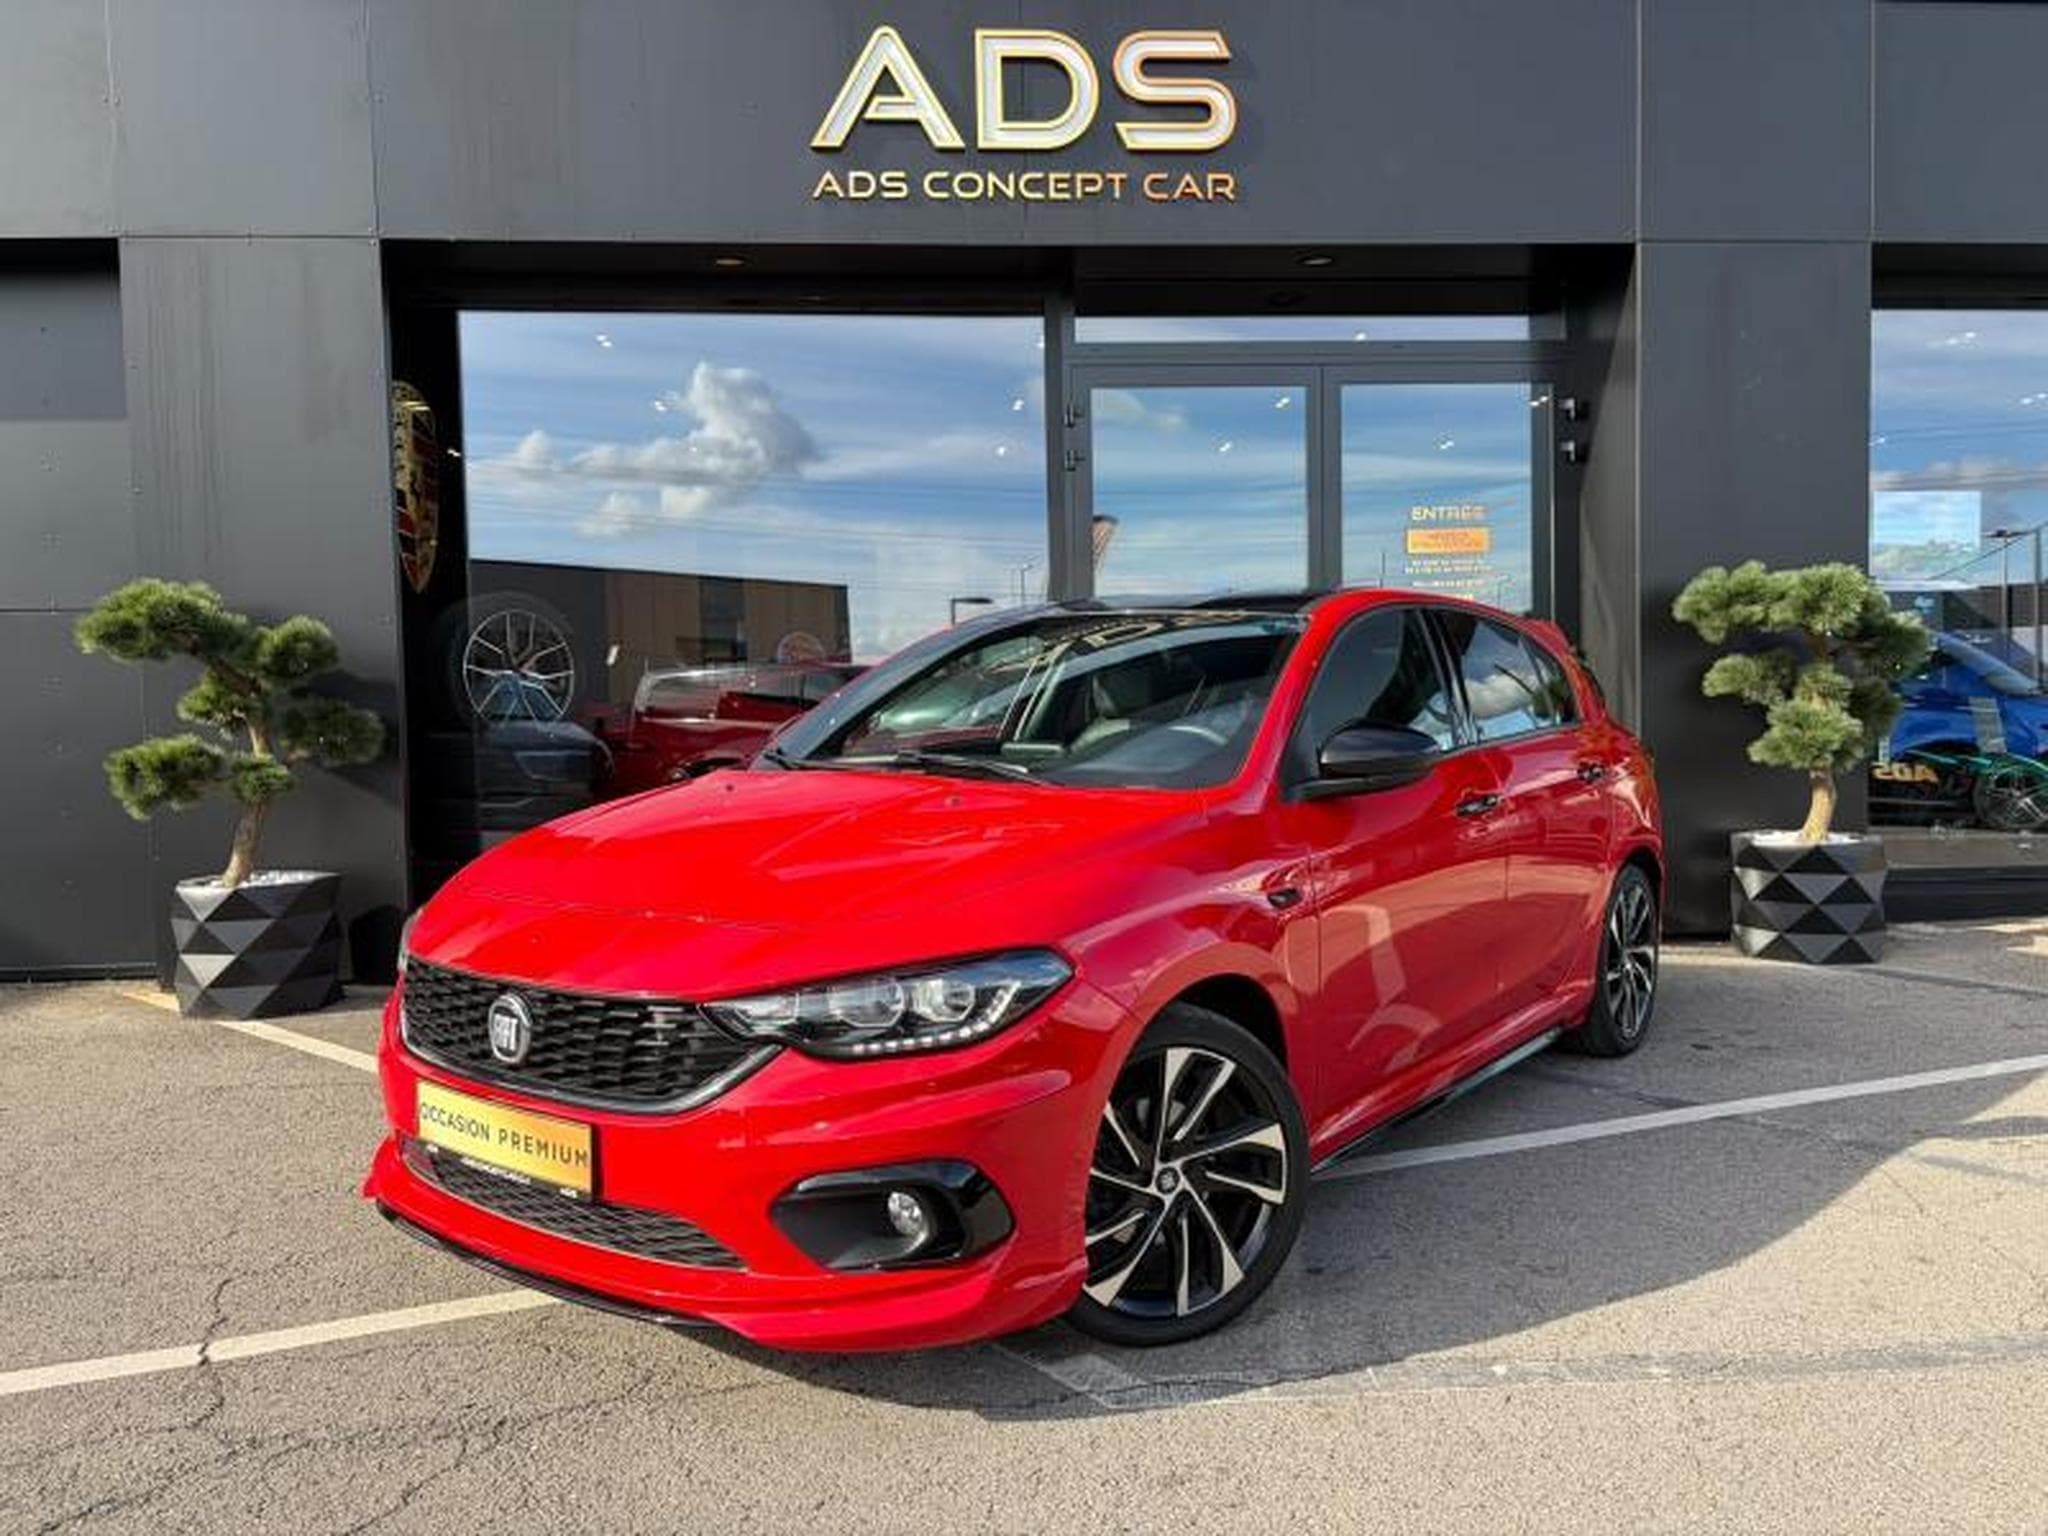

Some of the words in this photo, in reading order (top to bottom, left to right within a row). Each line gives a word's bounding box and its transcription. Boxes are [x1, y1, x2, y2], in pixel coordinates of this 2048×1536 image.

[810, 26, 1238, 150] ADS
[812, 170, 908, 200] ADS
[923, 170, 1127, 200] CONCEPT
[1143, 171, 1235, 200] CAR
[420, 1102, 490, 1142] OCCASION
[498, 1128, 588, 1168] PREMIUM
